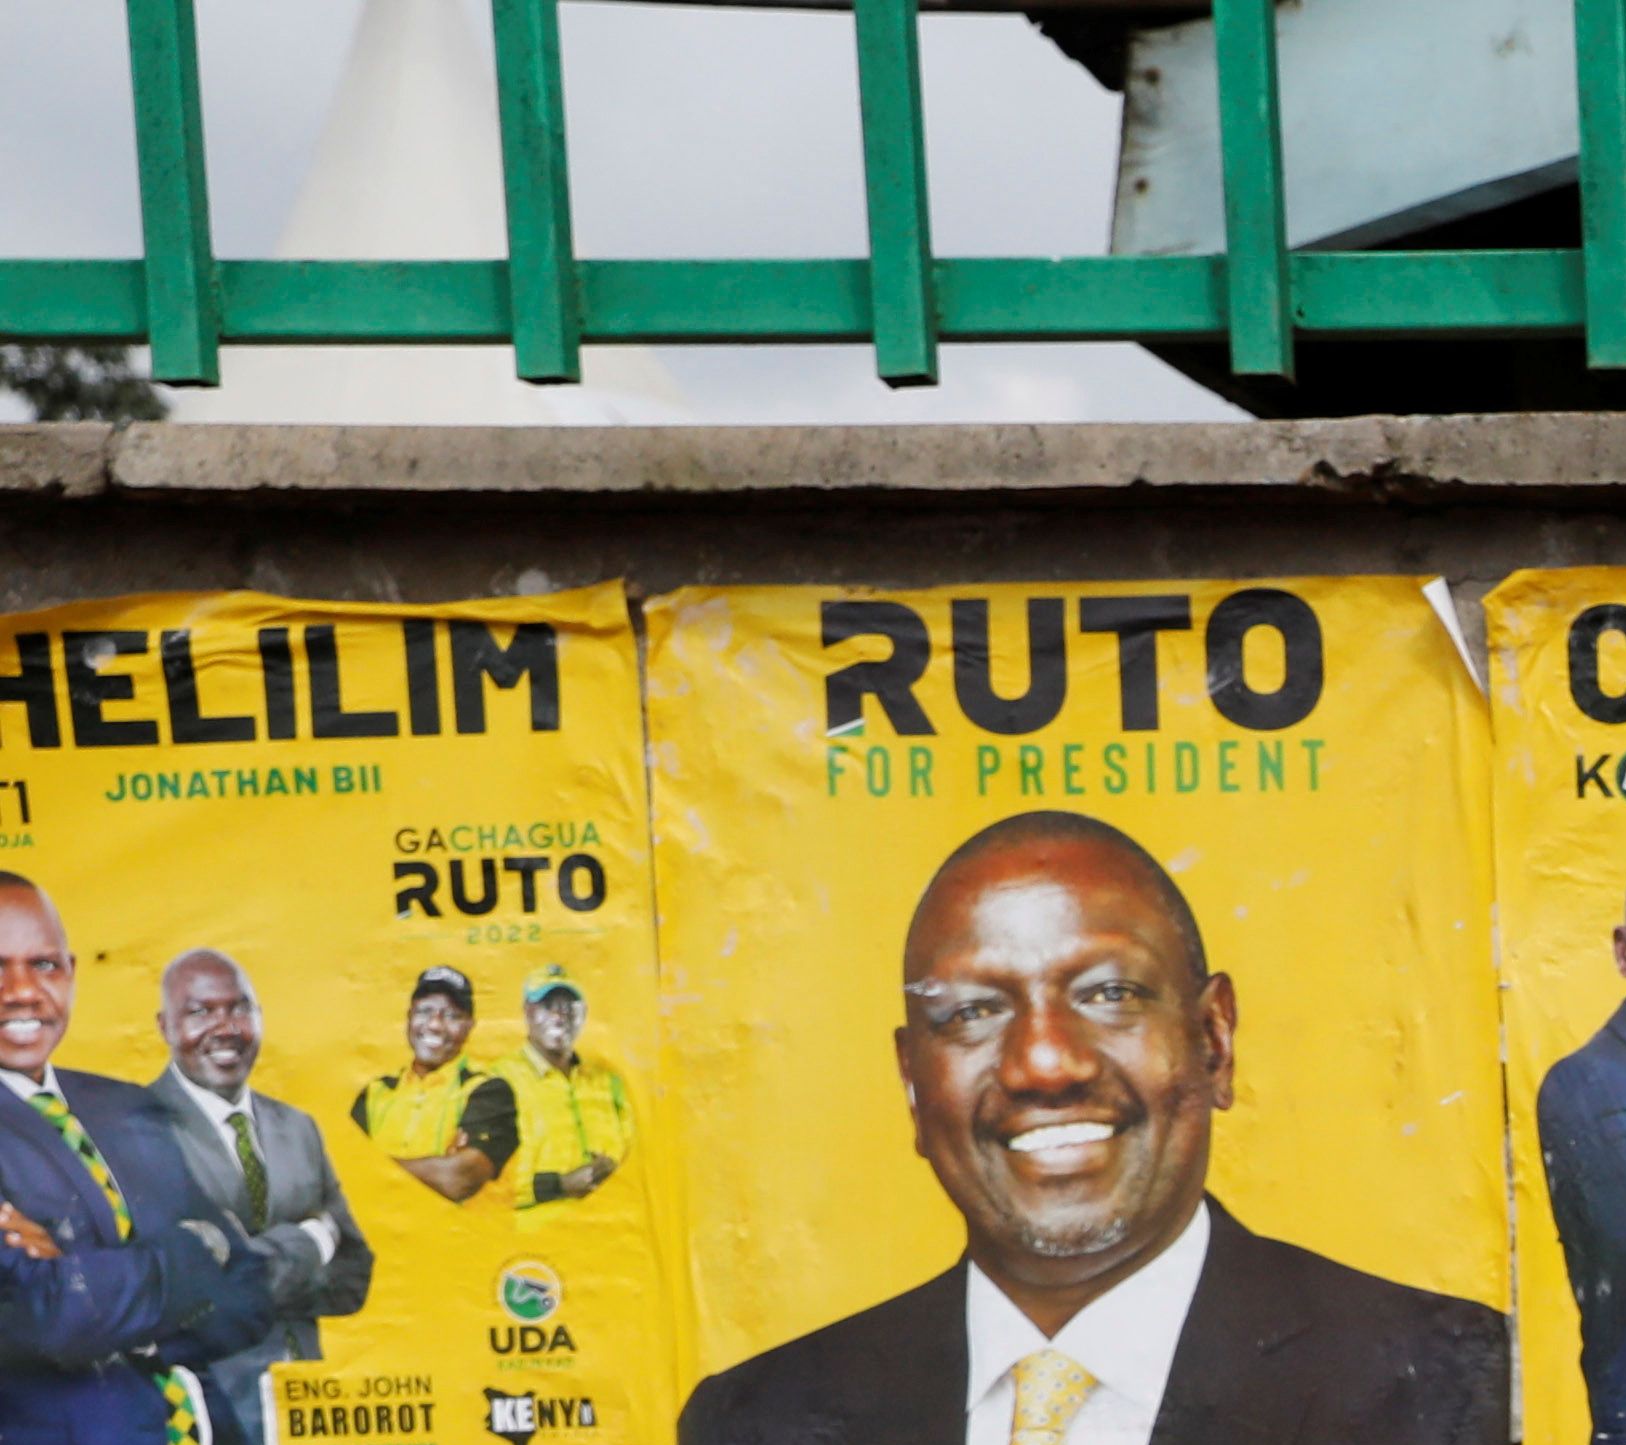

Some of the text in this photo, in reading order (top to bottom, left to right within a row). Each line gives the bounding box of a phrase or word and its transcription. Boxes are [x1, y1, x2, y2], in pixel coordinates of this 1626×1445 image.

[0, 618, 559, 748] HELILIM
[820, 588, 1324, 736] RUTO
[105, 766, 381, 802] JONATHAN BII
[827, 740, 1325, 797] FOR PRESIDENT
[395, 822, 601, 853] GACHAGUA
[392, 855, 608, 919] RUTO
[489, 1325, 577, 1355] UDA
[289, 1403, 435, 1437] BAROROT
